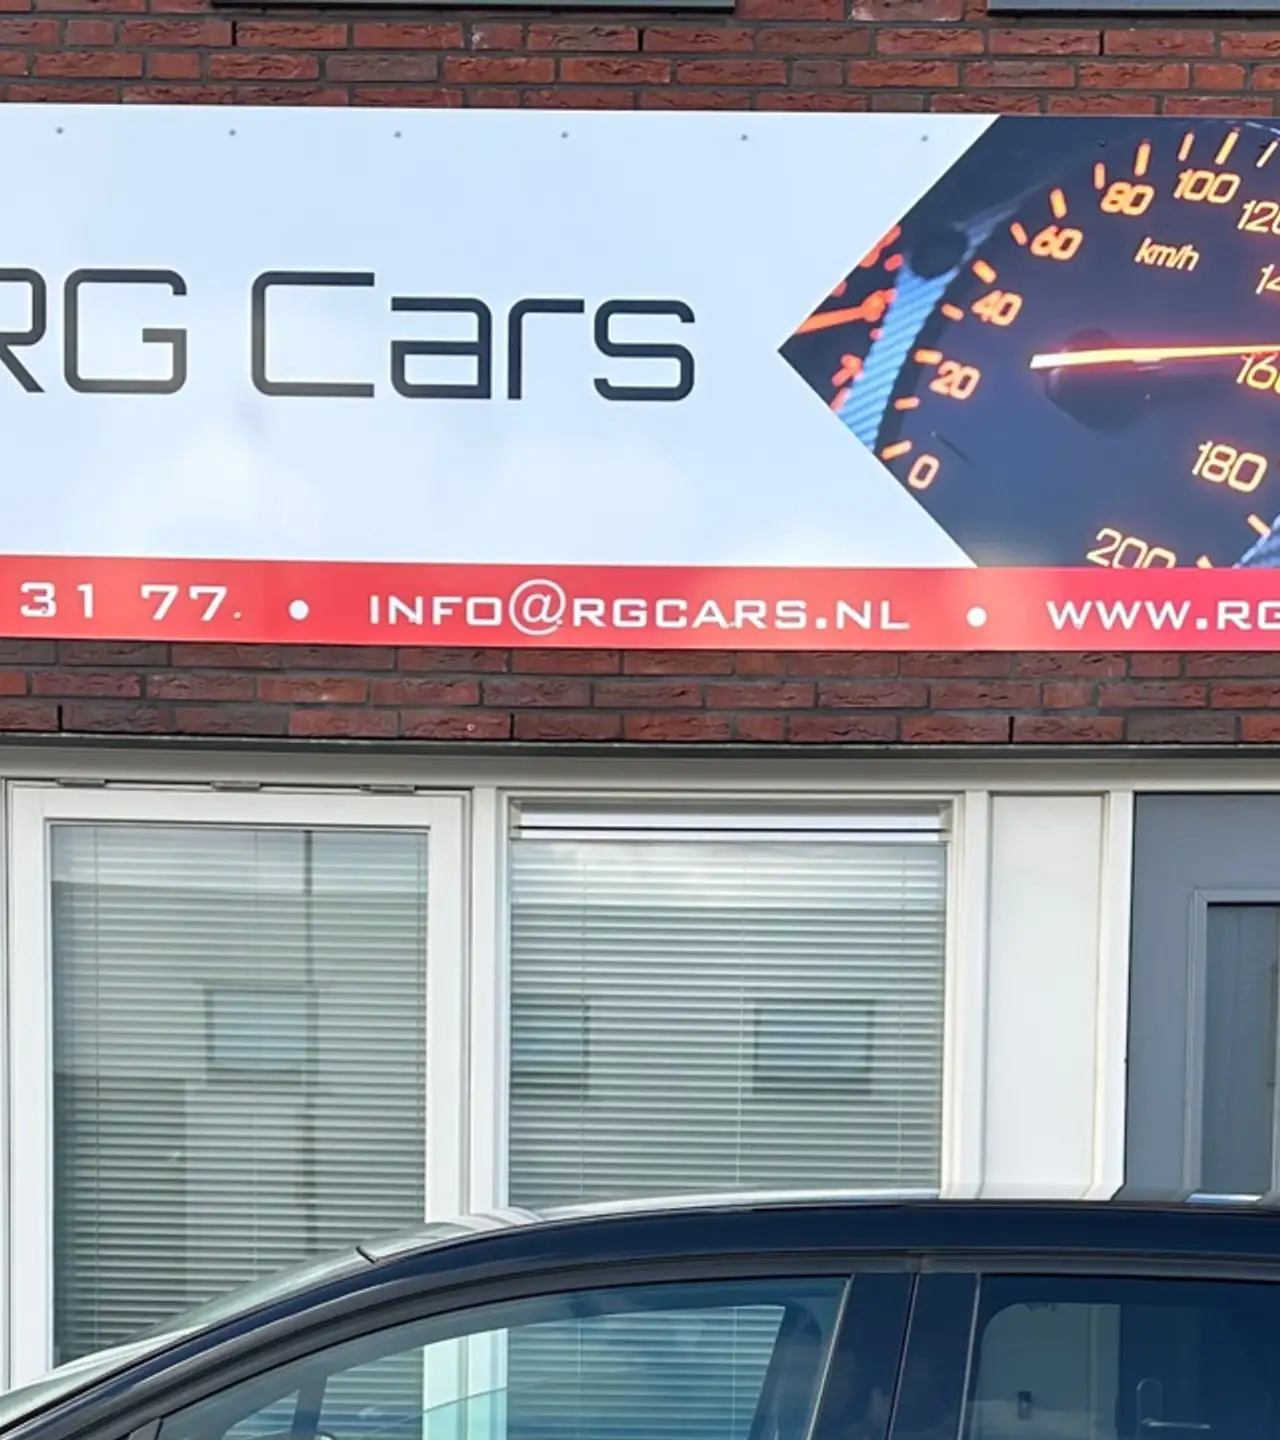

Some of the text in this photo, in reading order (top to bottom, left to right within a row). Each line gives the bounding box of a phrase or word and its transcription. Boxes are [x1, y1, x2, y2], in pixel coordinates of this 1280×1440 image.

[1100, 181, 1155, 216] 80
[1173, 168, 1241, 204] 100
[1030, 225, 1083, 260] 60
[1134, 236, 1200, 271] km/h
[971, 290, 1023, 326] 40
[250, 270, 696, 402] Cars
[929, 360, 981, 400] 20
[907, 454, 940, 490] 0
[1192, 440, 1268, 493] 180
[20, 581, 94, 619] 31
[369, 578, 910, 636] INFO@RGCARS.NL
